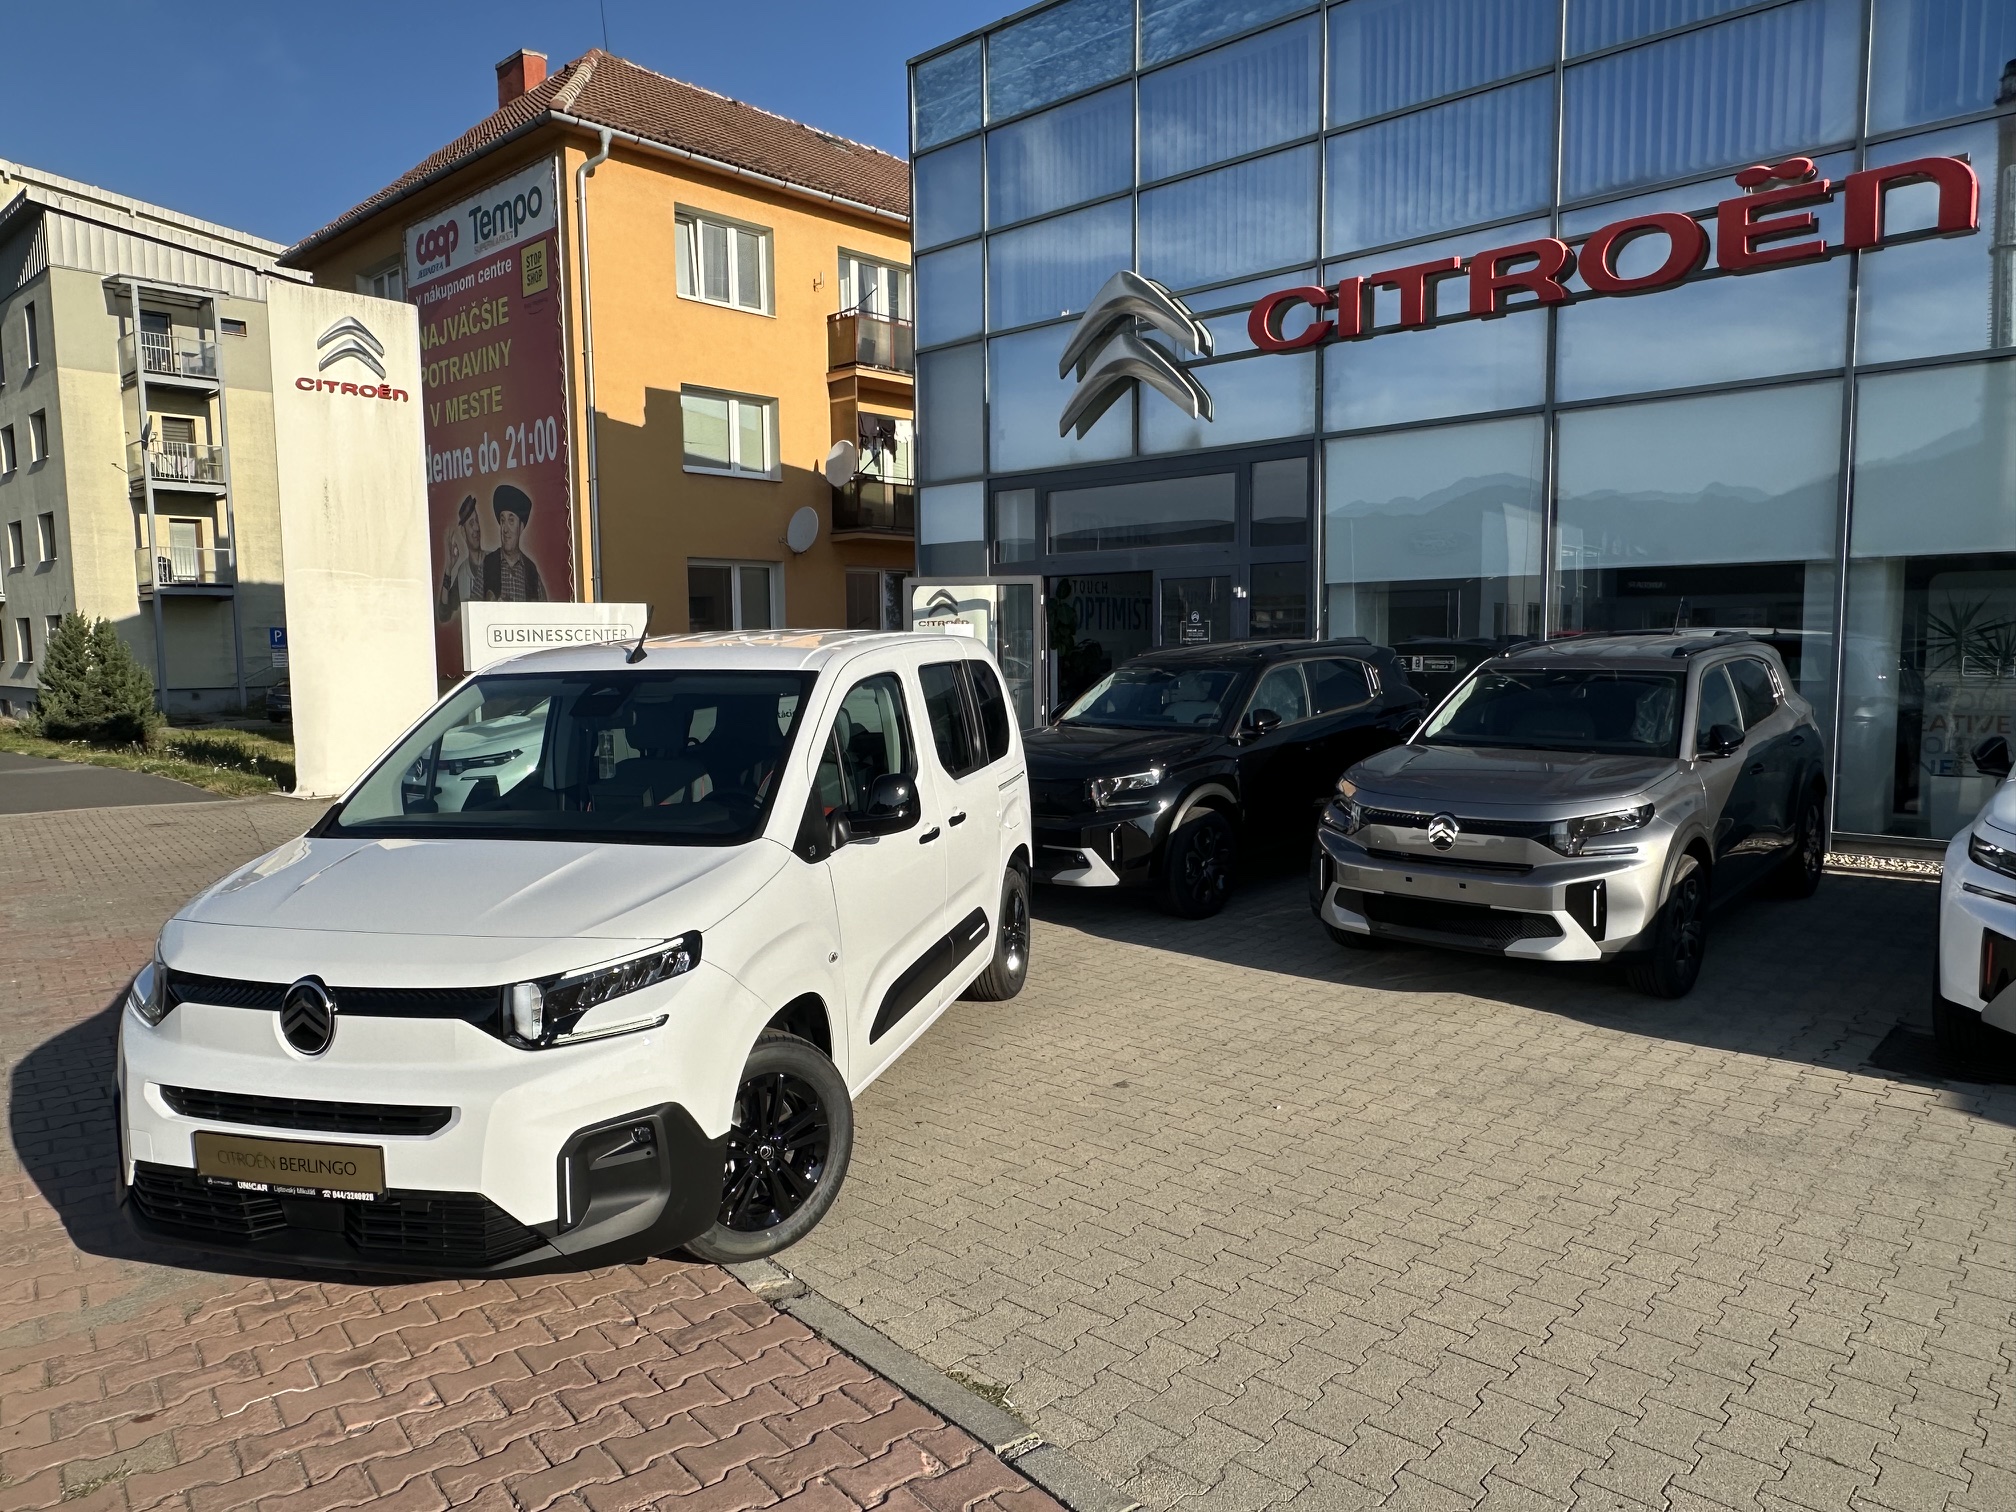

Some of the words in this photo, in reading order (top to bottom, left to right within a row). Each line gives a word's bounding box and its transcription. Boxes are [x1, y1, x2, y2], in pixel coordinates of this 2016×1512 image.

[469, 186, 542, 244] Tempo
[416, 220, 458, 267] coop
[526, 251, 542, 268] STOP
[424, 274, 475, 305] nákupnom
[478, 259, 512, 283] centre
[526, 269, 543, 287] SHOP
[419, 297, 509, 351] NAJVÄČŠIE
[421, 338, 512, 388] POTRAVINY
[430, 402, 440, 427] V
[445, 385, 503, 424] MESTE
[478, 432, 500, 475] do
[506, 415, 557, 469] 21:00
[1072, 580, 1108, 594] TOUCH
[274, 630, 282, 642] P
[493, 628, 627, 643] BUSINESSCENTER
[280, 1156, 357, 1176] BERLINGO
